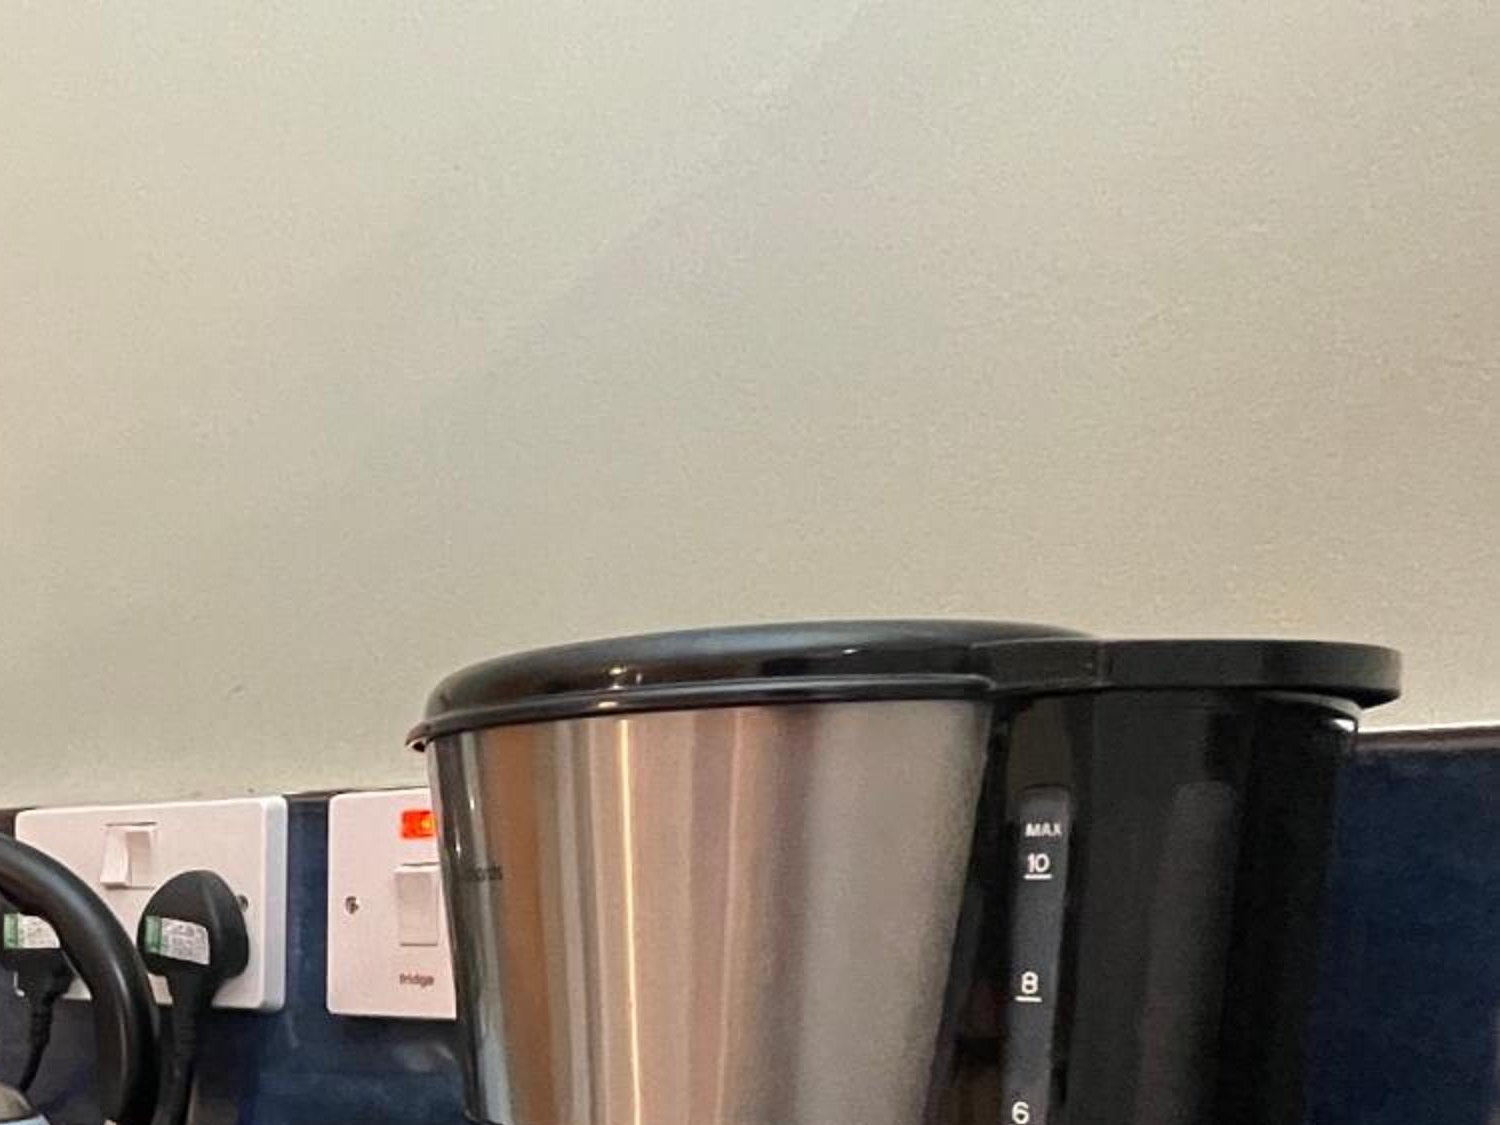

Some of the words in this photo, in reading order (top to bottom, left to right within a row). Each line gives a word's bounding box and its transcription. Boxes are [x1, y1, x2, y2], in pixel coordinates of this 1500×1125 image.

[1025, 823, 1063, 837] MAX
[1027, 852, 1050, 874] 10
[398, 973, 435, 989] fridge
[1021, 970, 1039, 995] 8
[1012, 1100, 1029, 1125] 6
